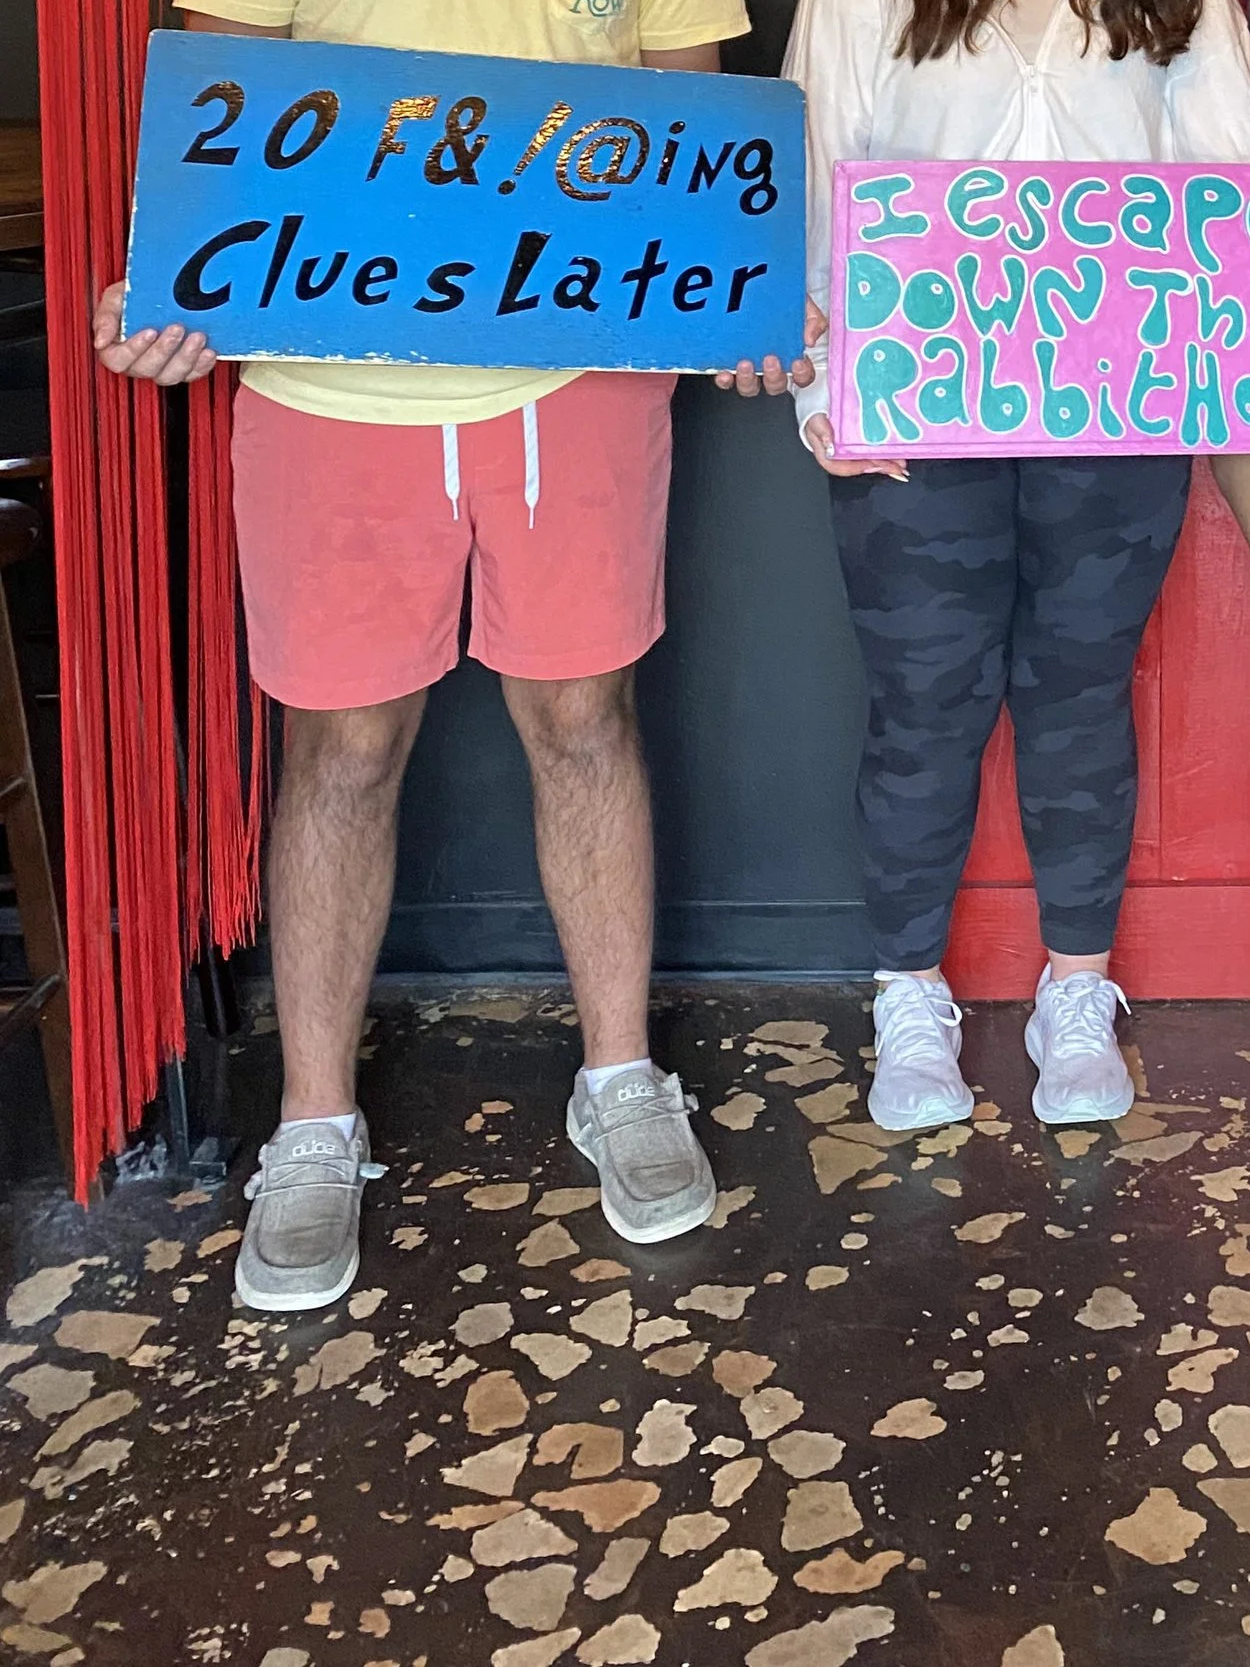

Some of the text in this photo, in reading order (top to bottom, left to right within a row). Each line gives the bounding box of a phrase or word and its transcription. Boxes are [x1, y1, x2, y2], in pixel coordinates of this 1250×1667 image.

[181, 80, 341, 171] 20
[852, 174, 932, 242] I
[172, 214, 769, 321] Clues Later
